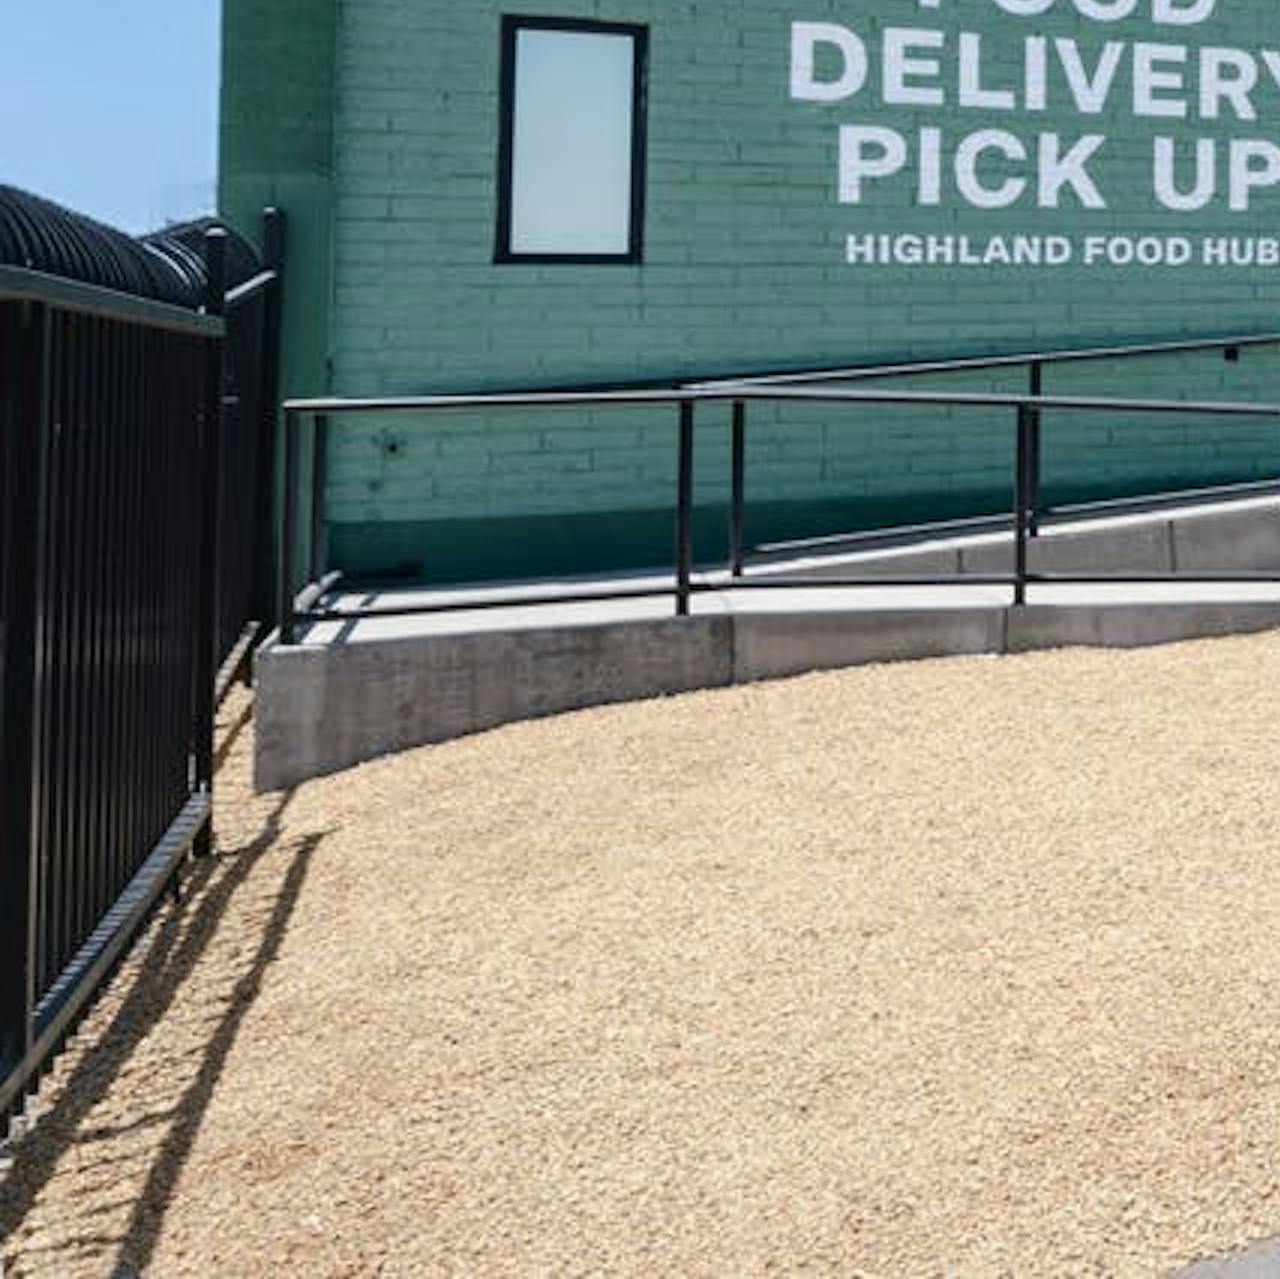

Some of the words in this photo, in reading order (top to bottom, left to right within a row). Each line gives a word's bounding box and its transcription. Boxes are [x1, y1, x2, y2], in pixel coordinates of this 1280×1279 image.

[838, 125, 1107, 209] PICK
[846, 234, 1072, 264] HIGHLAND
[1083, 236, 1191, 265] FOOD
[1203, 238, 1280, 266] HUB
